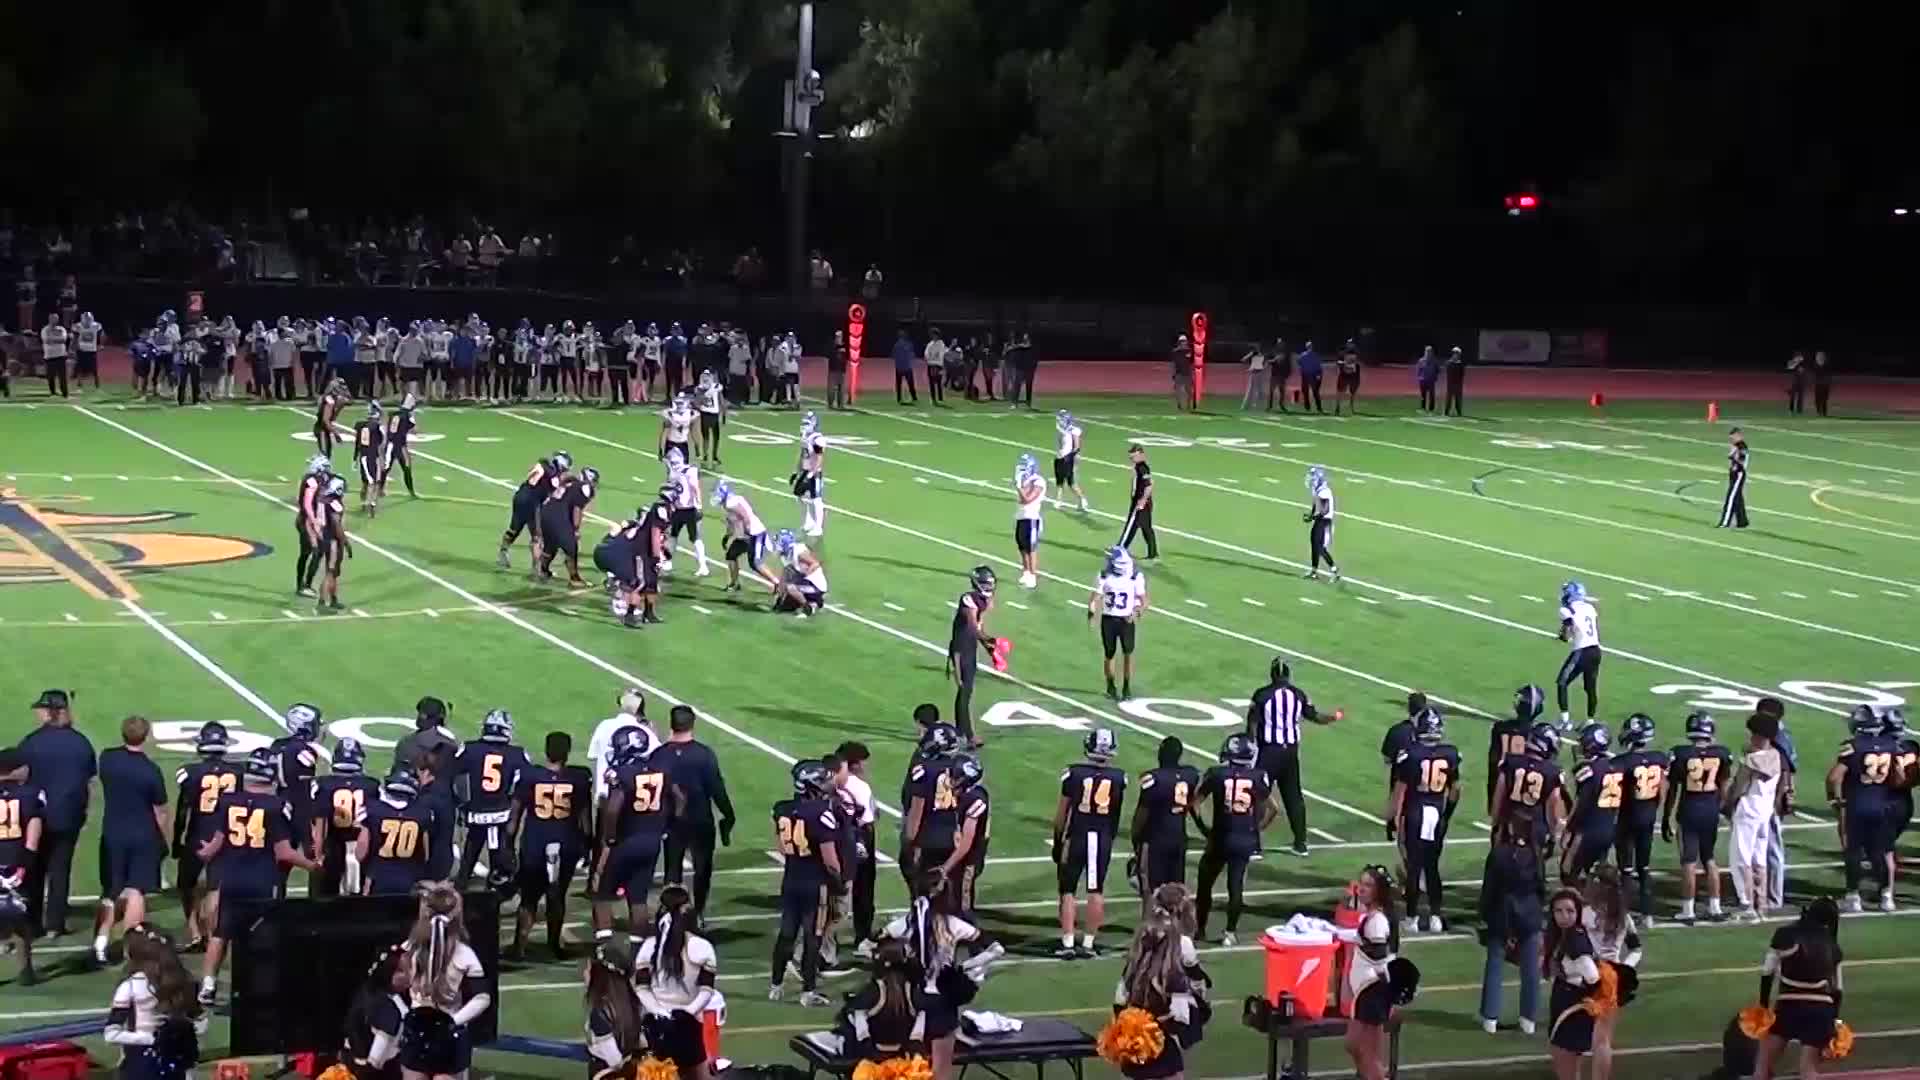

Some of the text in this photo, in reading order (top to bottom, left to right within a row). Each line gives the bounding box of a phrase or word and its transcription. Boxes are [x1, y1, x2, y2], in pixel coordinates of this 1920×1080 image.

[1104, 591, 1128, 610] 33
[1584, 615, 1594, 637] 3
[980, 698, 1243, 730] 40
[482, 754, 503, 793] 5
[633, 772, 664, 812] 57
[1416, 759, 1449, 793] 16
[1510, 767, 1544, 806] 13
[1686, 757, 1720, 792] 27
[534, 783, 573, 820] 55
[1078, 777, 1111, 814] 14
[1223, 778, 1253, 813] 15
[228, 805, 266, 848] 54
[378, 819, 420, 858] 70
[778, 816, 812, 858] 24
